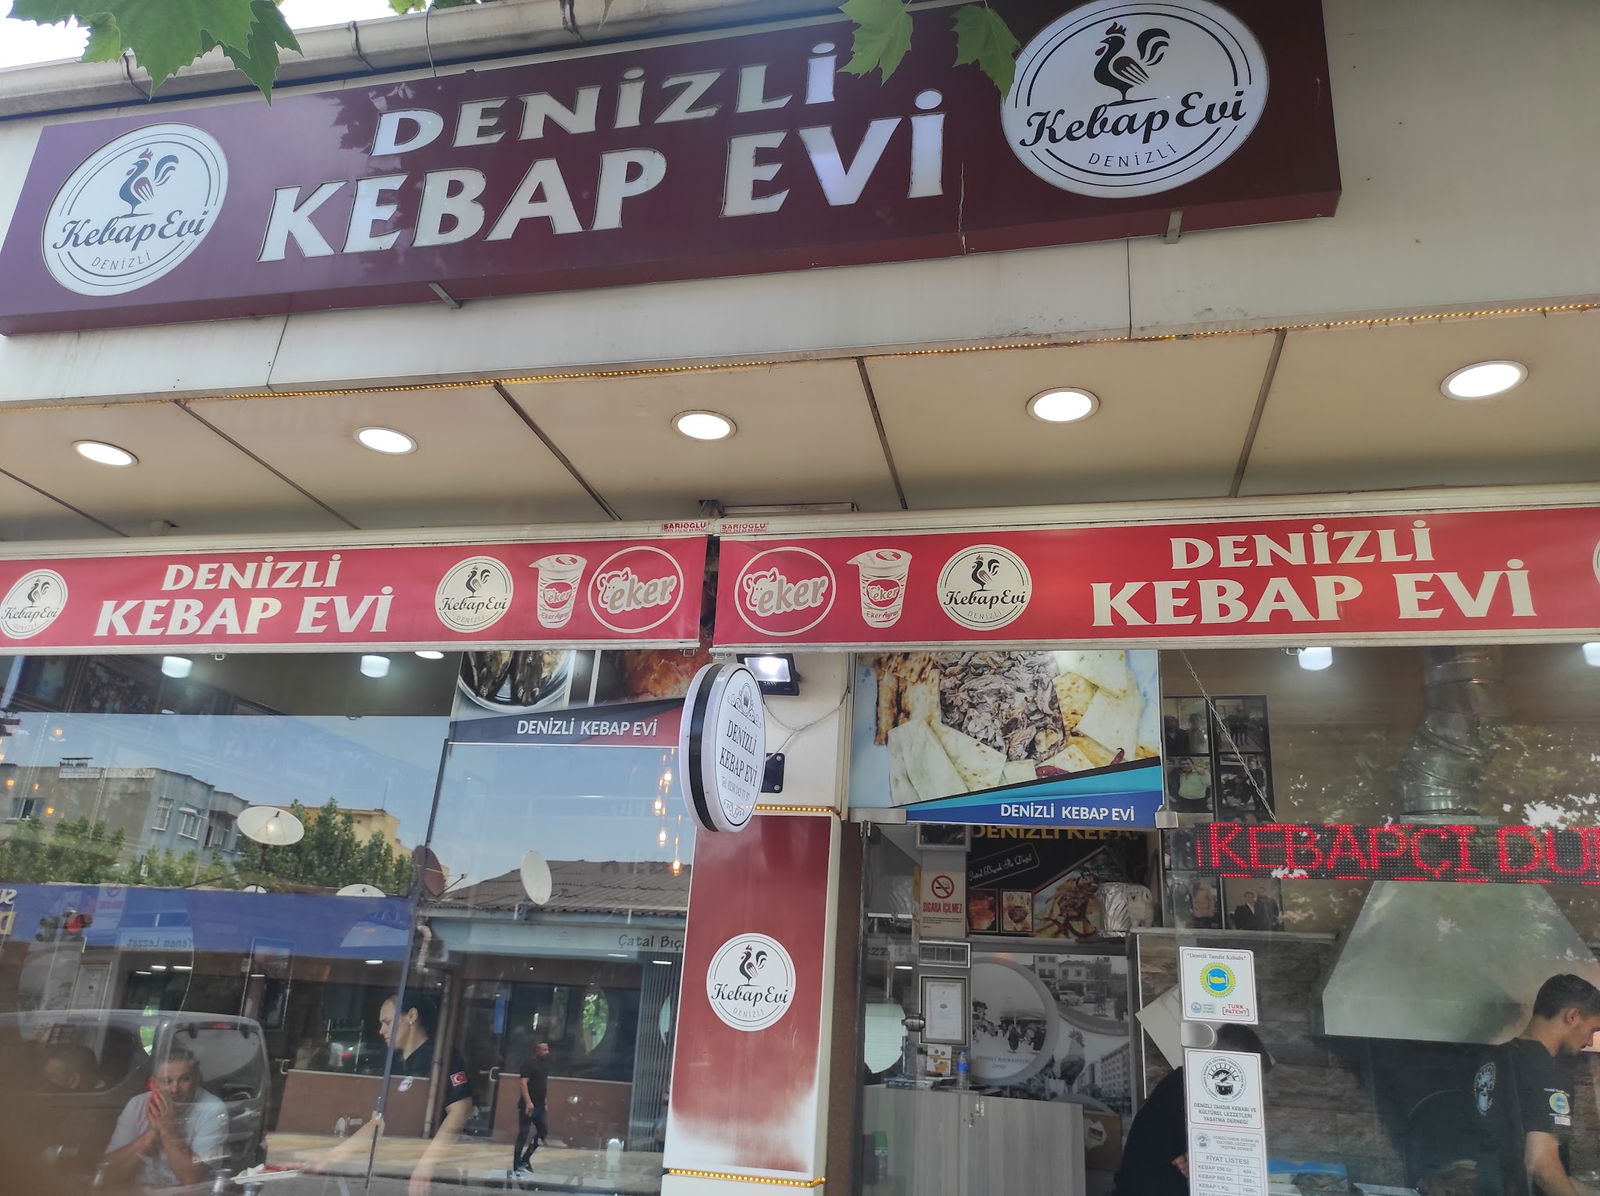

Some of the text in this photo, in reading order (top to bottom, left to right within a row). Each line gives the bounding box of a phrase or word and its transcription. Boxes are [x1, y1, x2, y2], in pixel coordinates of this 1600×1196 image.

[371, 42, 838, 157] DENİZLİ
[1019, 90, 1247, 147] Kebap Evi
[1088, 141, 1177, 168] DENİZLİ
[256, 90, 946, 263] KEBAP EVİ
[52, 209, 207, 251] Kebap Evi
[91, 250, 152, 271] DENİZLİ
[1169, 519, 1436, 571] DENİZLİ
[161, 554, 342, 592] DENİZLİ
[93, 585, 394, 637] KEBAP EVİ
[438, 597, 485, 614] Kebap
[609, 576, 677, 615] eker
[757, 578, 828, 617] eker
[943, 589, 1026, 610] Kebap Evi
[1091, 558, 1538, 627] KEBAP EVİ
[516, 717, 659, 736] DENİZLİ KEBAP EVİ
[726, 719, 757, 757] DENİZLİ
[719, 747, 744, 782] KEBAP
[1000, 802, 1135, 822] DENİZLİ KEBAP EVİ
[1209, 823, 1479, 878] KEBAPÇI
[711, 983, 789, 1007] Kebap Evi
